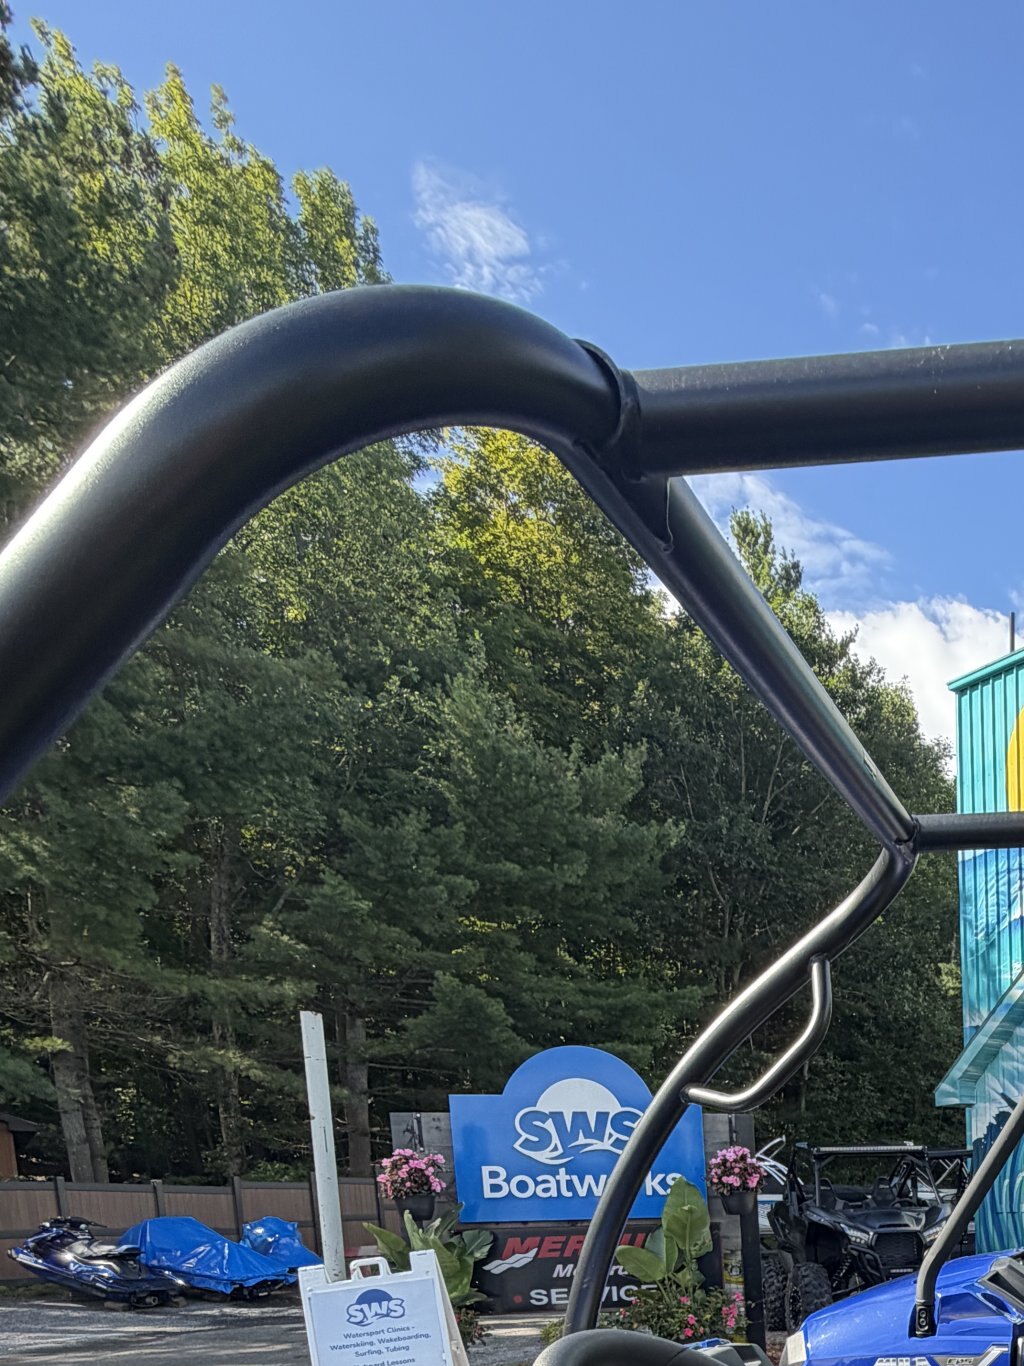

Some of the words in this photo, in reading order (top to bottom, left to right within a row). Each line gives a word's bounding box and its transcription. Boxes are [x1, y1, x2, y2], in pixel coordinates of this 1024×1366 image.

[514, 1107, 642, 1160] SWS
[346, 1297, 405, 1327] SWS
[343, 1328, 385, 1339] Watersport
[386, 1326, 410, 1334] Clinics
[385, 1345, 410, 1353] Tubing
[387, 1357, 416, 1366] Lessons
